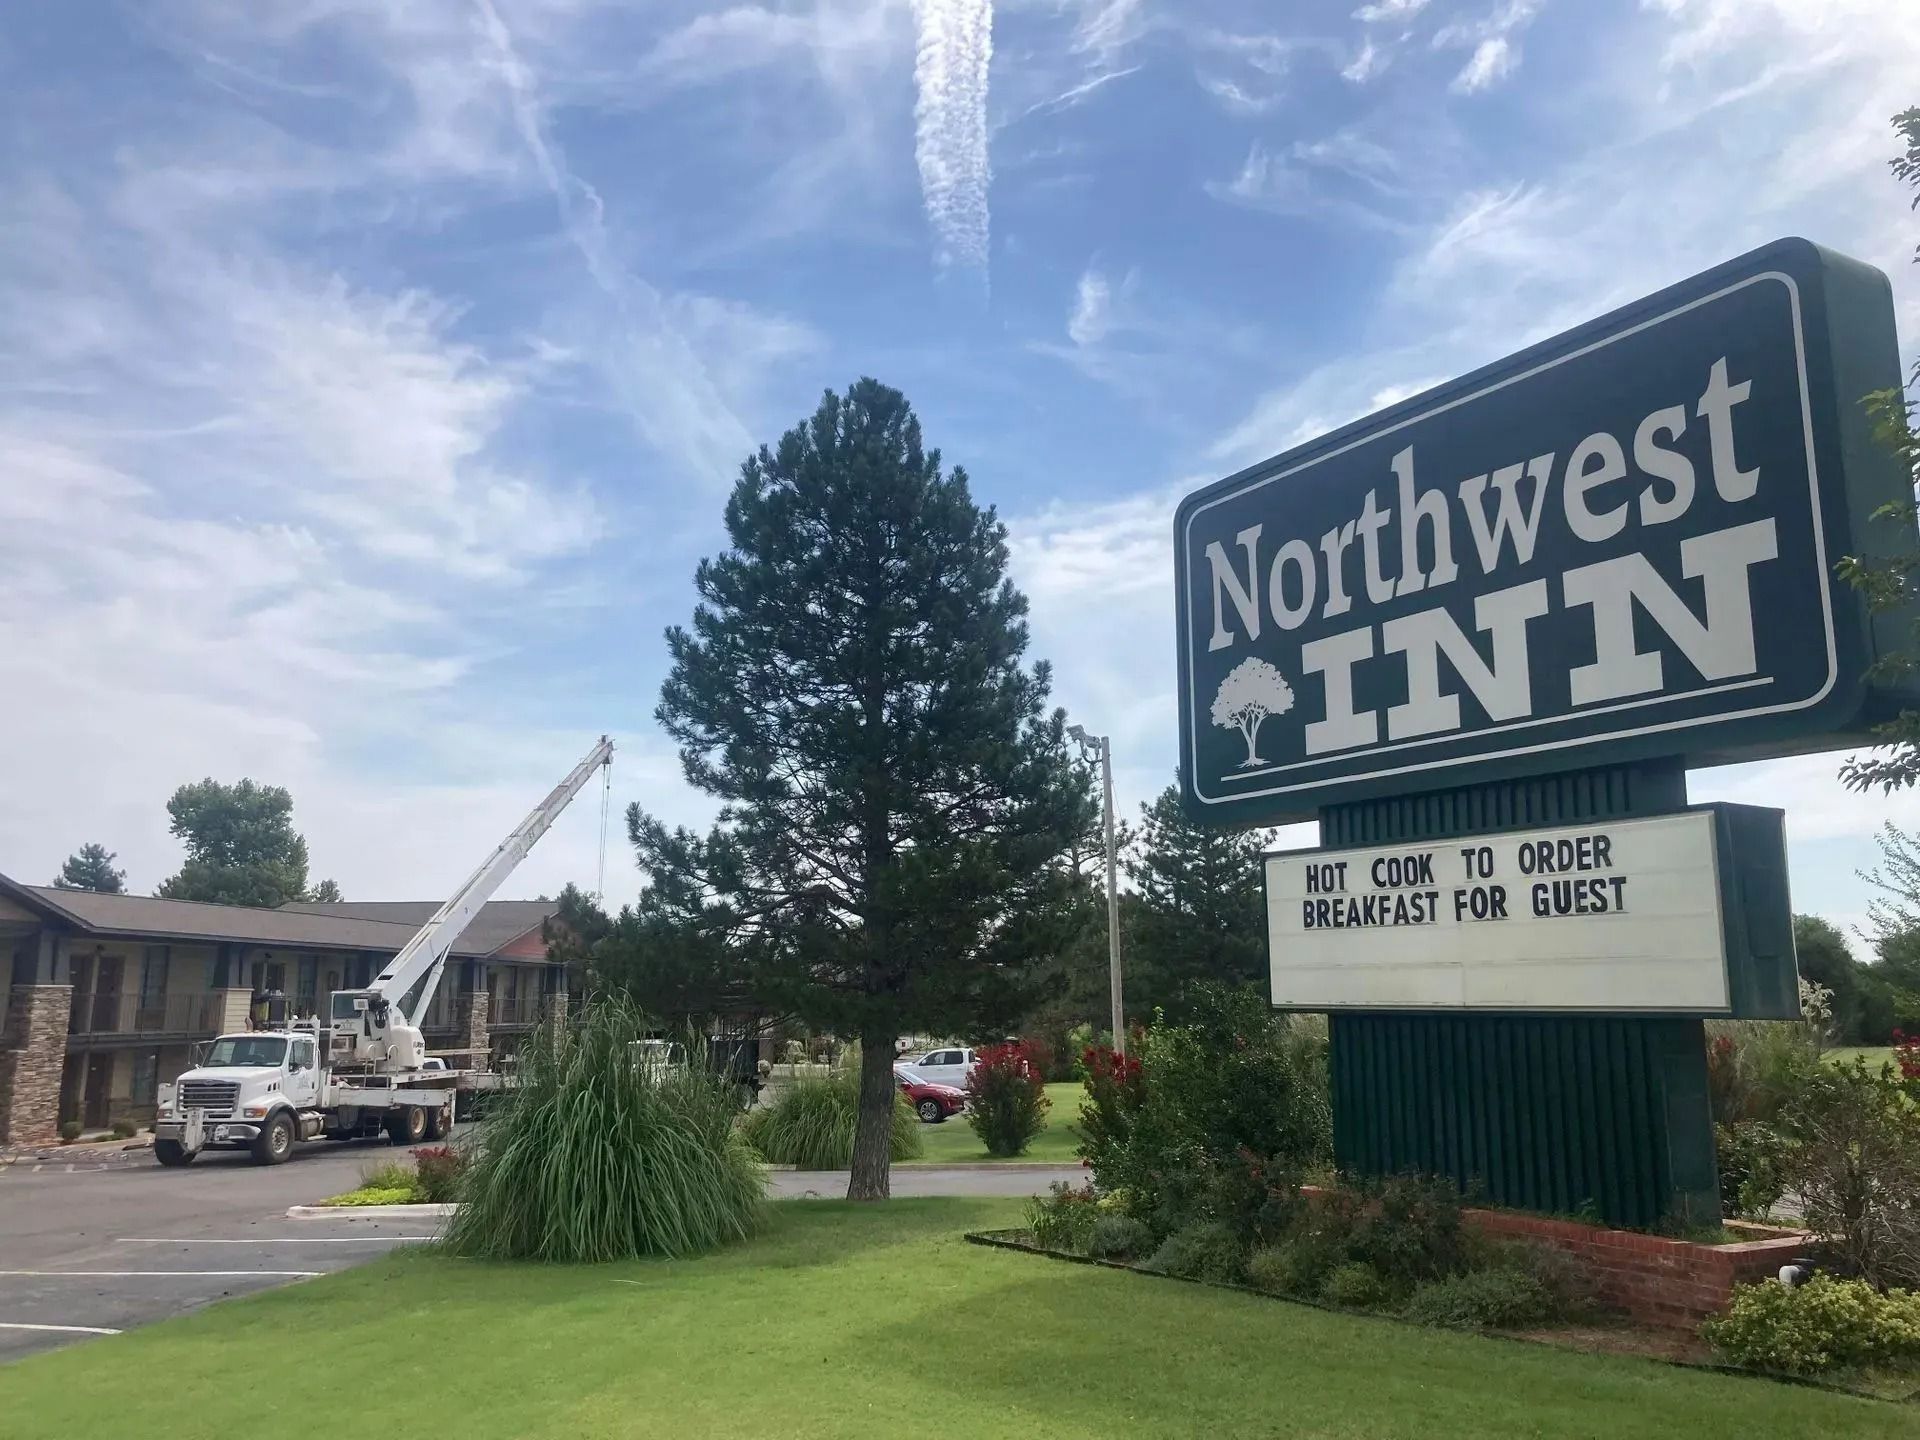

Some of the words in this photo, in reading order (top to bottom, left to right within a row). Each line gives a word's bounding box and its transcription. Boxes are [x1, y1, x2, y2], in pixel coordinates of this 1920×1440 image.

[1206, 357, 1760, 651] Northwest
[1302, 518, 1778, 754] INN
[1303, 891, 1439, 928] BREAKFAST
[1454, 885, 1507, 921] FOR
[1532, 876, 1627, 917] GUEST
[1306, 863, 1347, 893] HOT
[1371, 854, 1433, 888] COOK
[1461, 847, 1493, 879] TO
[1518, 835, 1612, 875] ORDER
